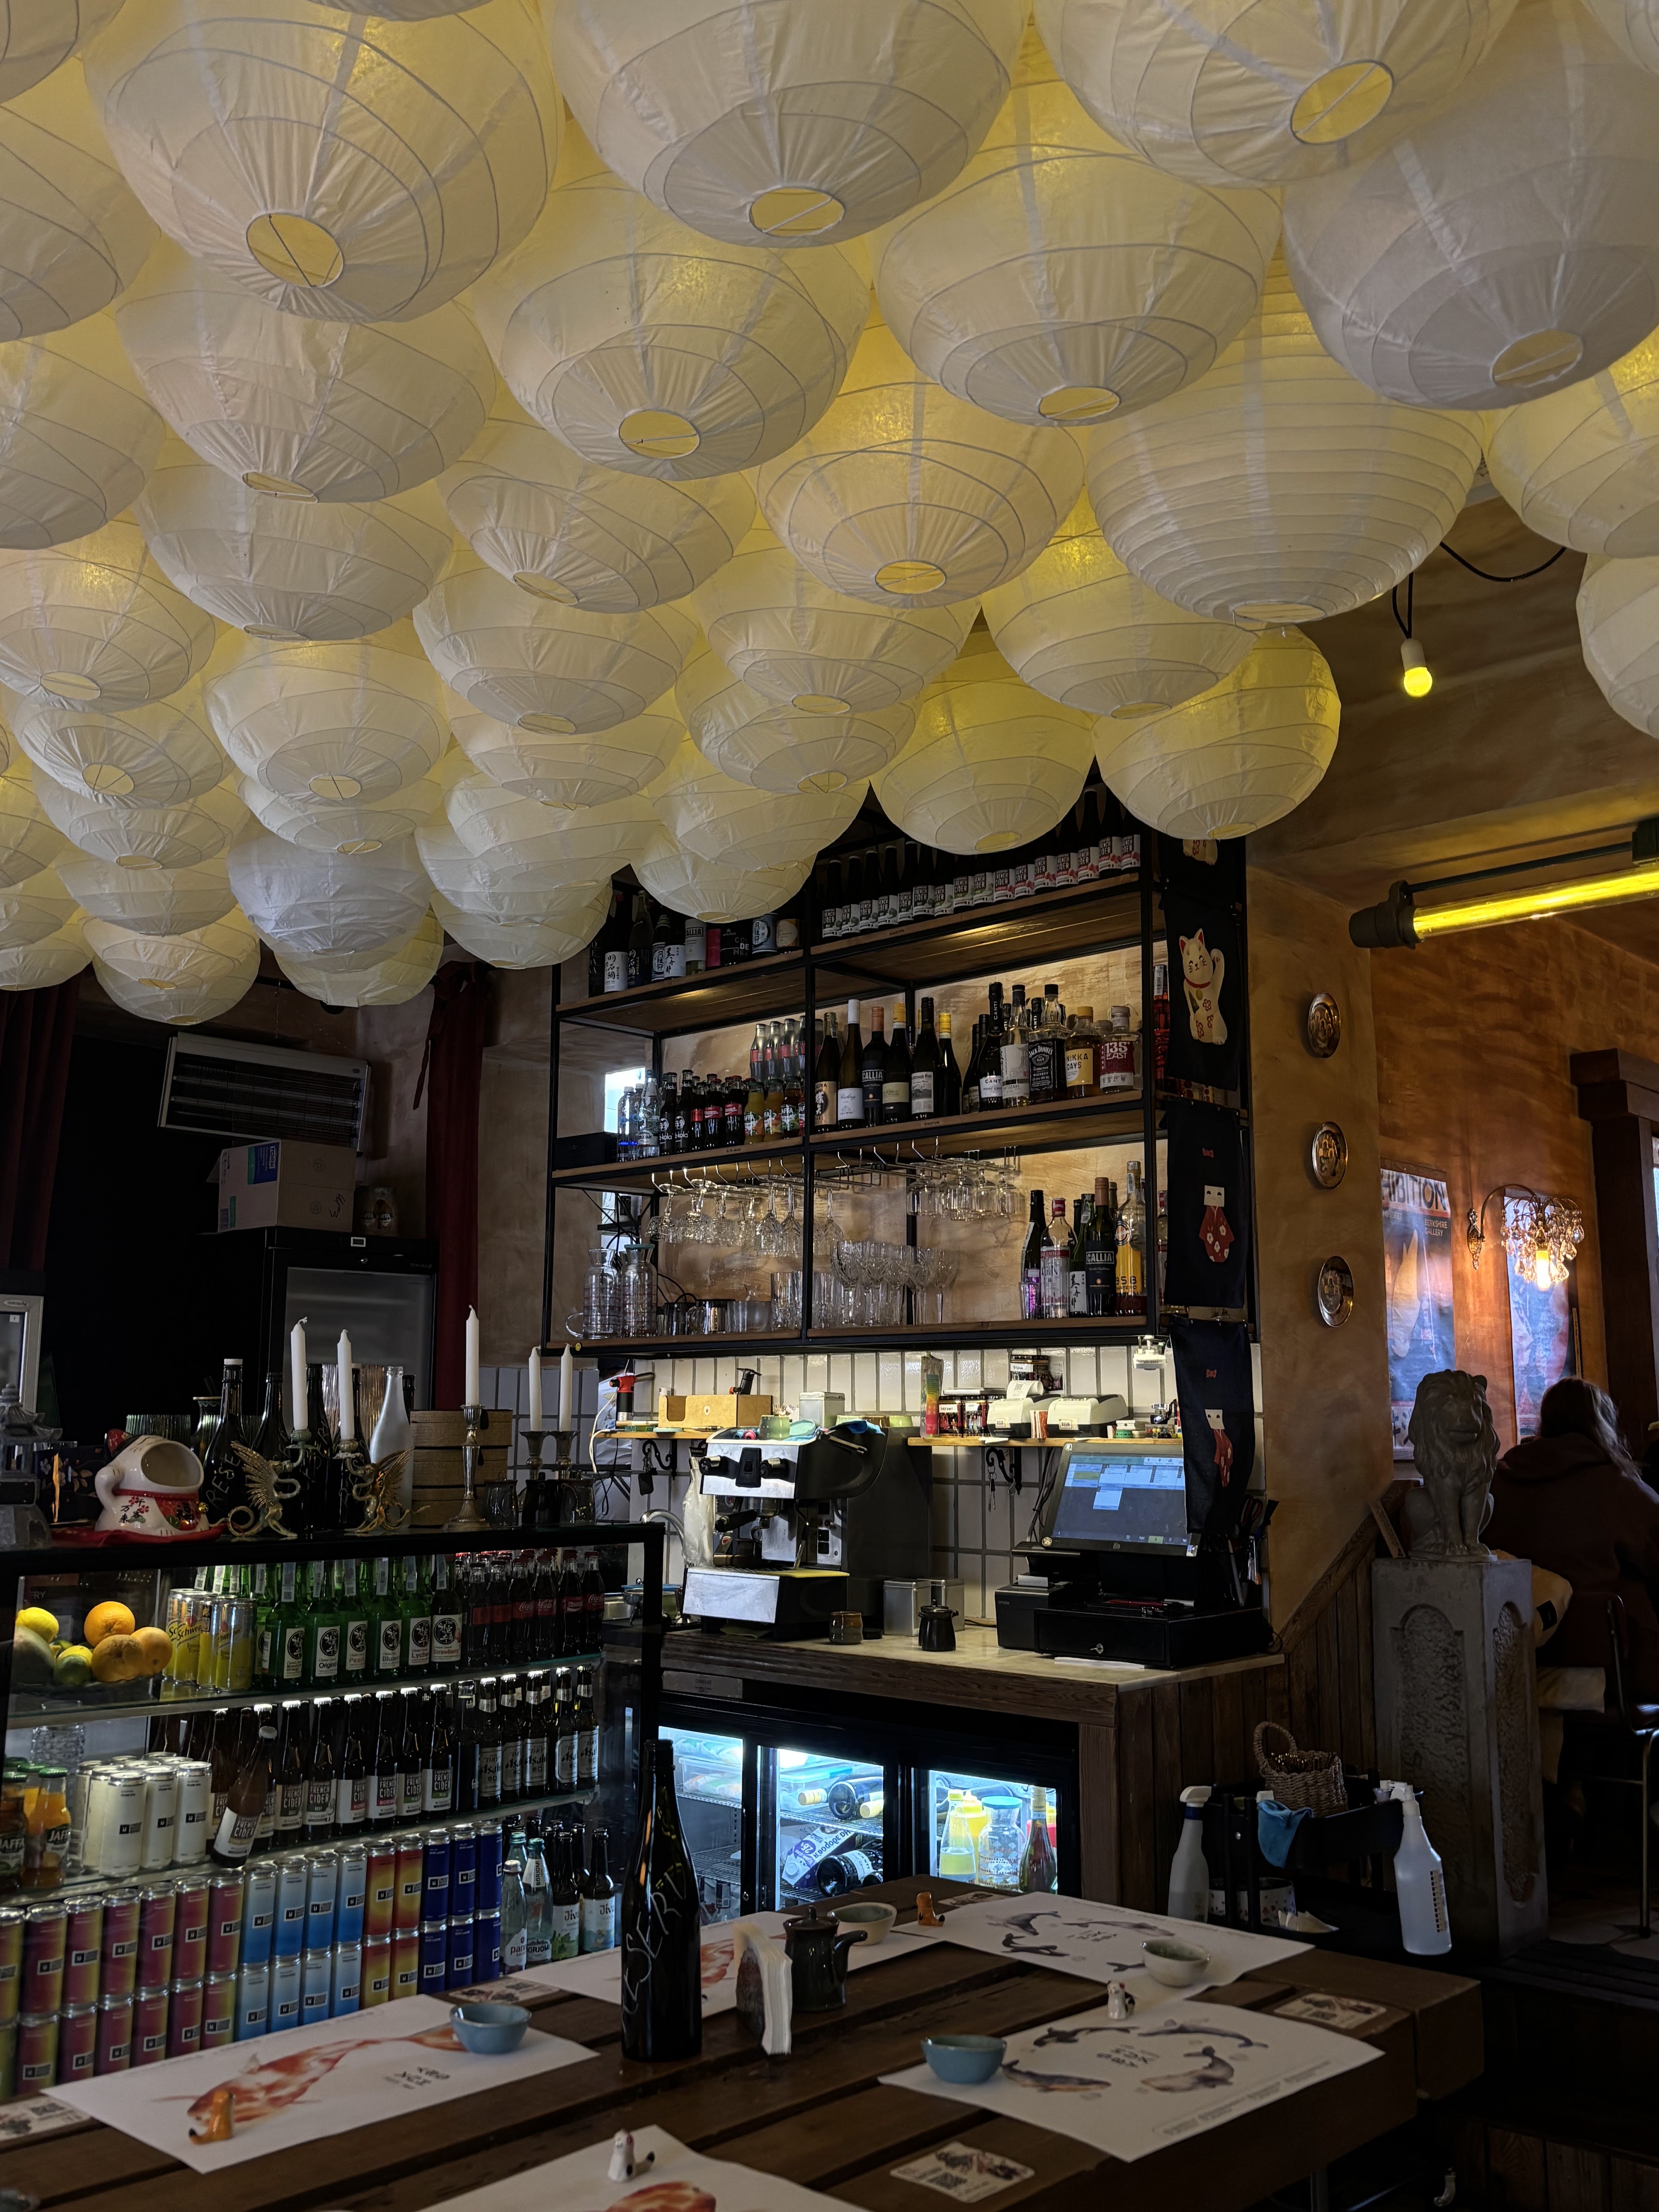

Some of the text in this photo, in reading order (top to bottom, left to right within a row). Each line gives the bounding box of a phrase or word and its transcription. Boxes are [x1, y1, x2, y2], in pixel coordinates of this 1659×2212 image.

[740, 942, 749, 951] DE
[1029, 1047, 1038, 1059] JACK
[1066, 1053, 1088, 1062] NIKKA
[1106, 1052, 1128, 1060] EAST
[1067, 1062, 1082, 1071] DAYS
[862, 1071, 883, 1080] CALLIA
[1424, 1219, 1447, 1229] BERKSHIRE
[1424, 1227, 1443, 1237] GALLERY
[1087, 1252, 1113, 1263] CALLIA
[310, 1785, 330, 1794] FRENCH
[309, 1794, 329, 1804] CIDER
